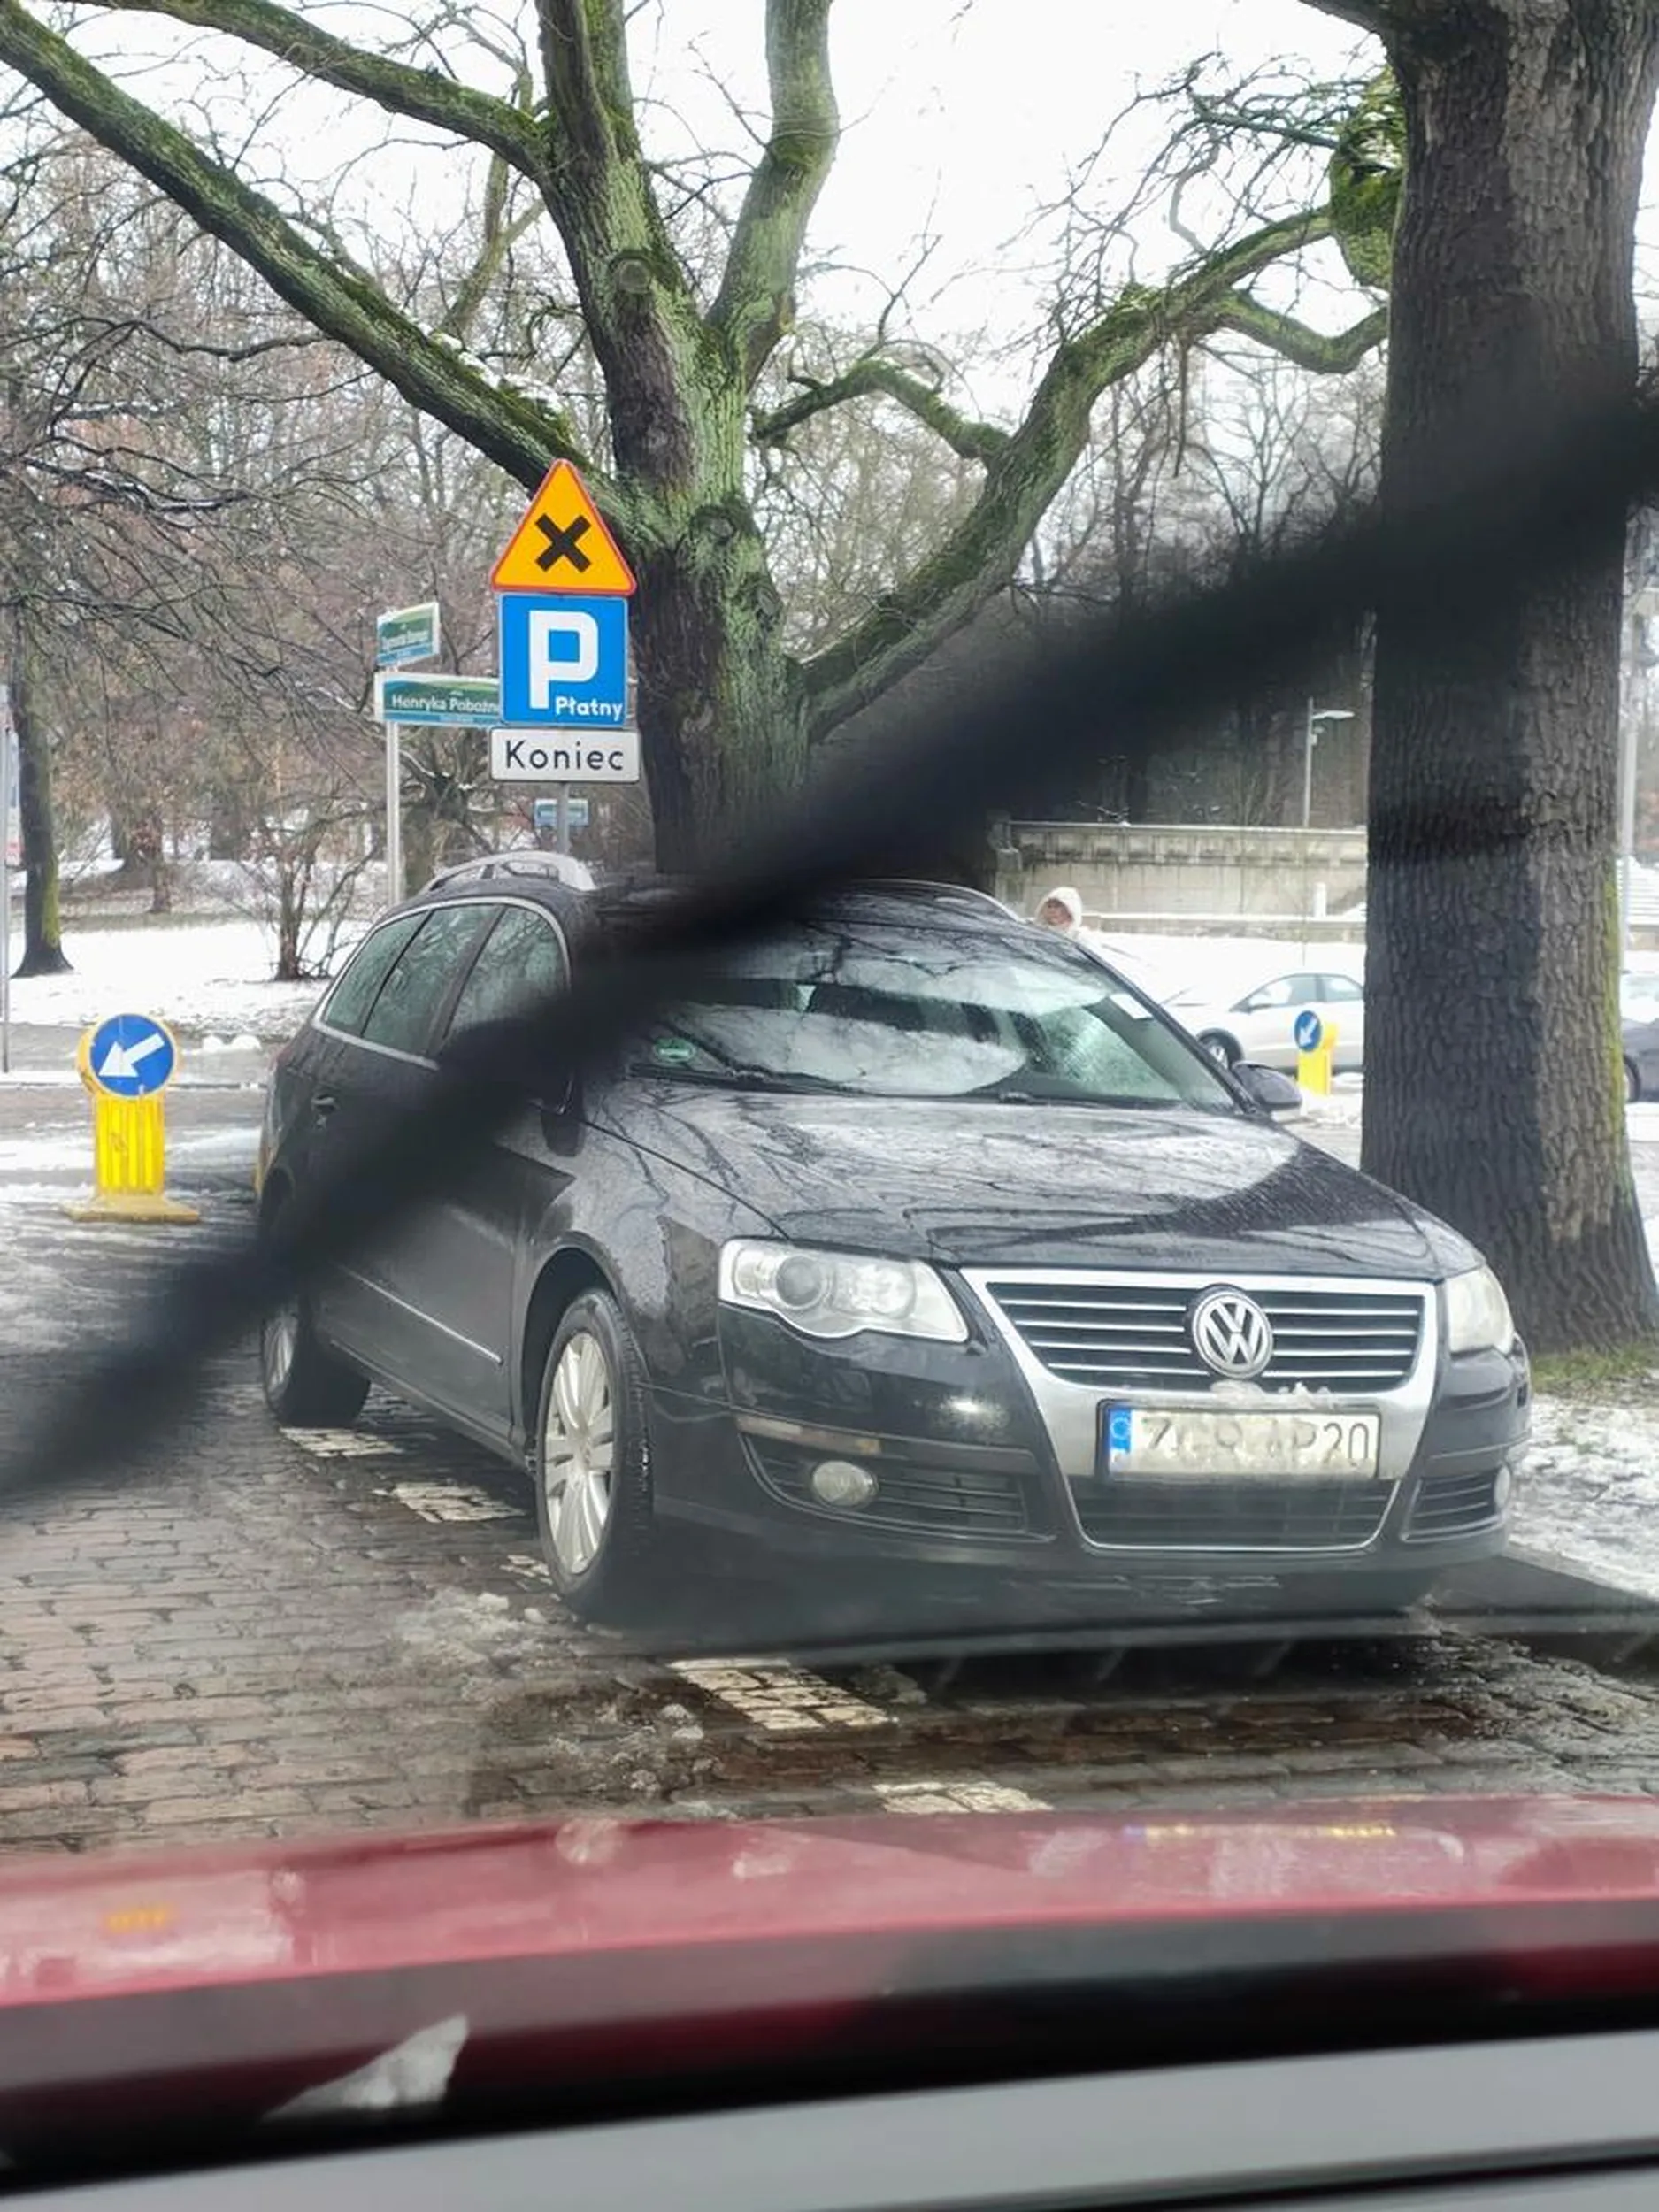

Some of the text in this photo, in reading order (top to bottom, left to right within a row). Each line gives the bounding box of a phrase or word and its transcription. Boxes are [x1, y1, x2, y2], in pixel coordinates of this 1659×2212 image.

[528, 610, 599, 710] P
[391, 695, 498, 712] Henryka Pobożn
[555, 695, 623, 721] Płatny
[505, 739, 624, 770] Koniec
